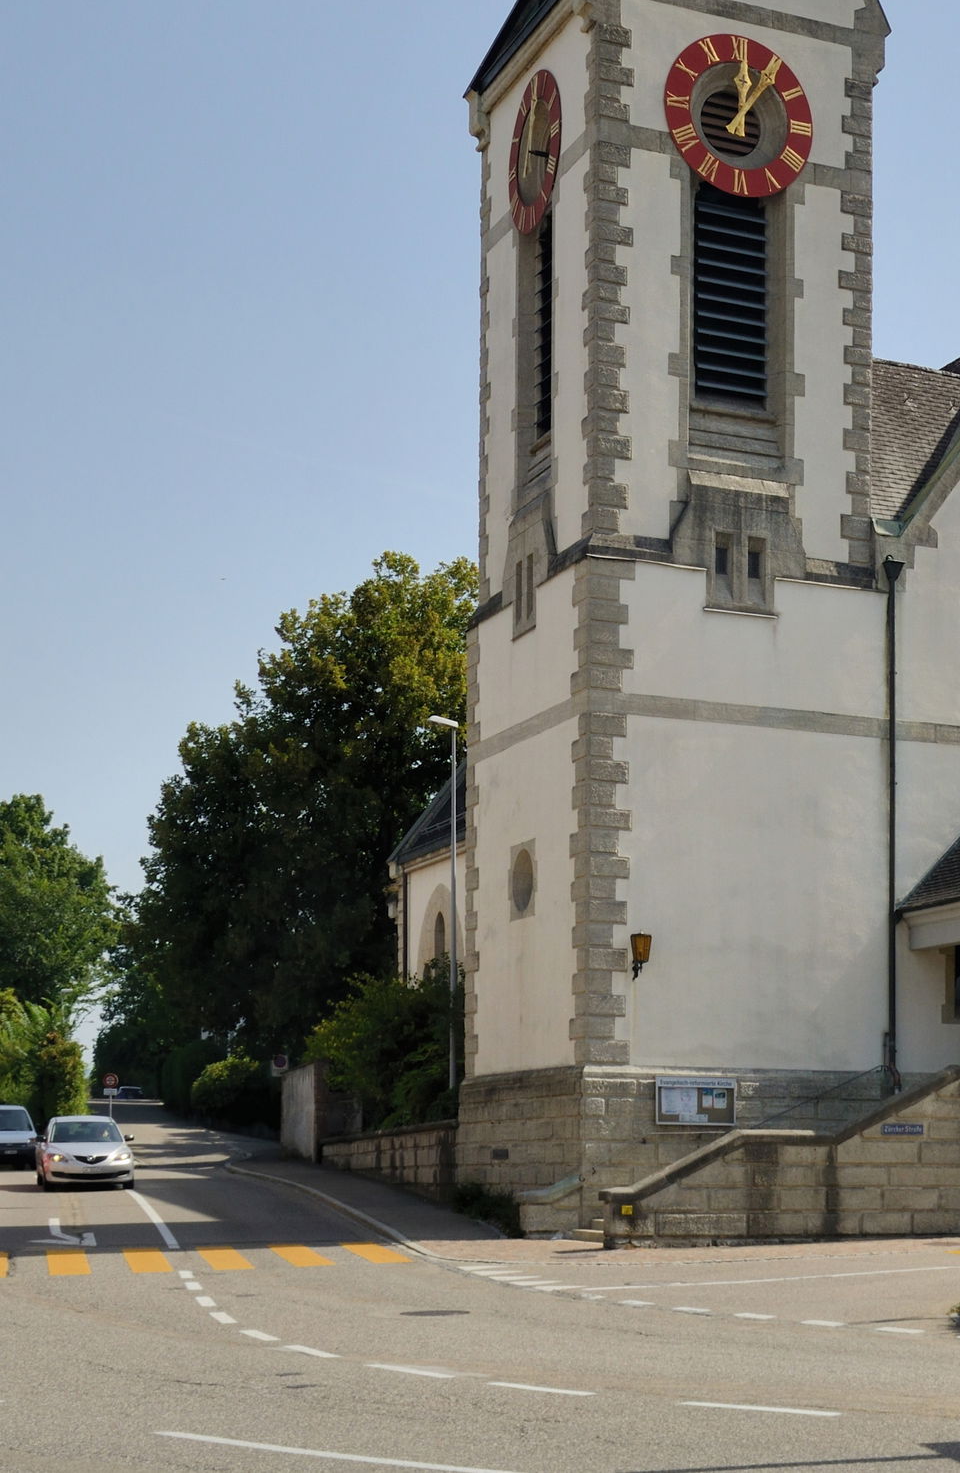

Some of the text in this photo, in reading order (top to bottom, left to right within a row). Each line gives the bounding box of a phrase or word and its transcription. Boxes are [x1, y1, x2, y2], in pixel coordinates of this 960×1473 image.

[698, 37, 720, 64] XI
[674, 58, 698, 81] X
[666, 90, 690, 110] IX
[782, 86, 803, 101] II
[672, 123, 700, 153] VIII
[790, 119, 811, 137] III
[697, 152, 720, 182] VII
[780, 145, 806, 173] IIII
[732, 169, 749, 195] VI
[764, 167, 782, 192] V
